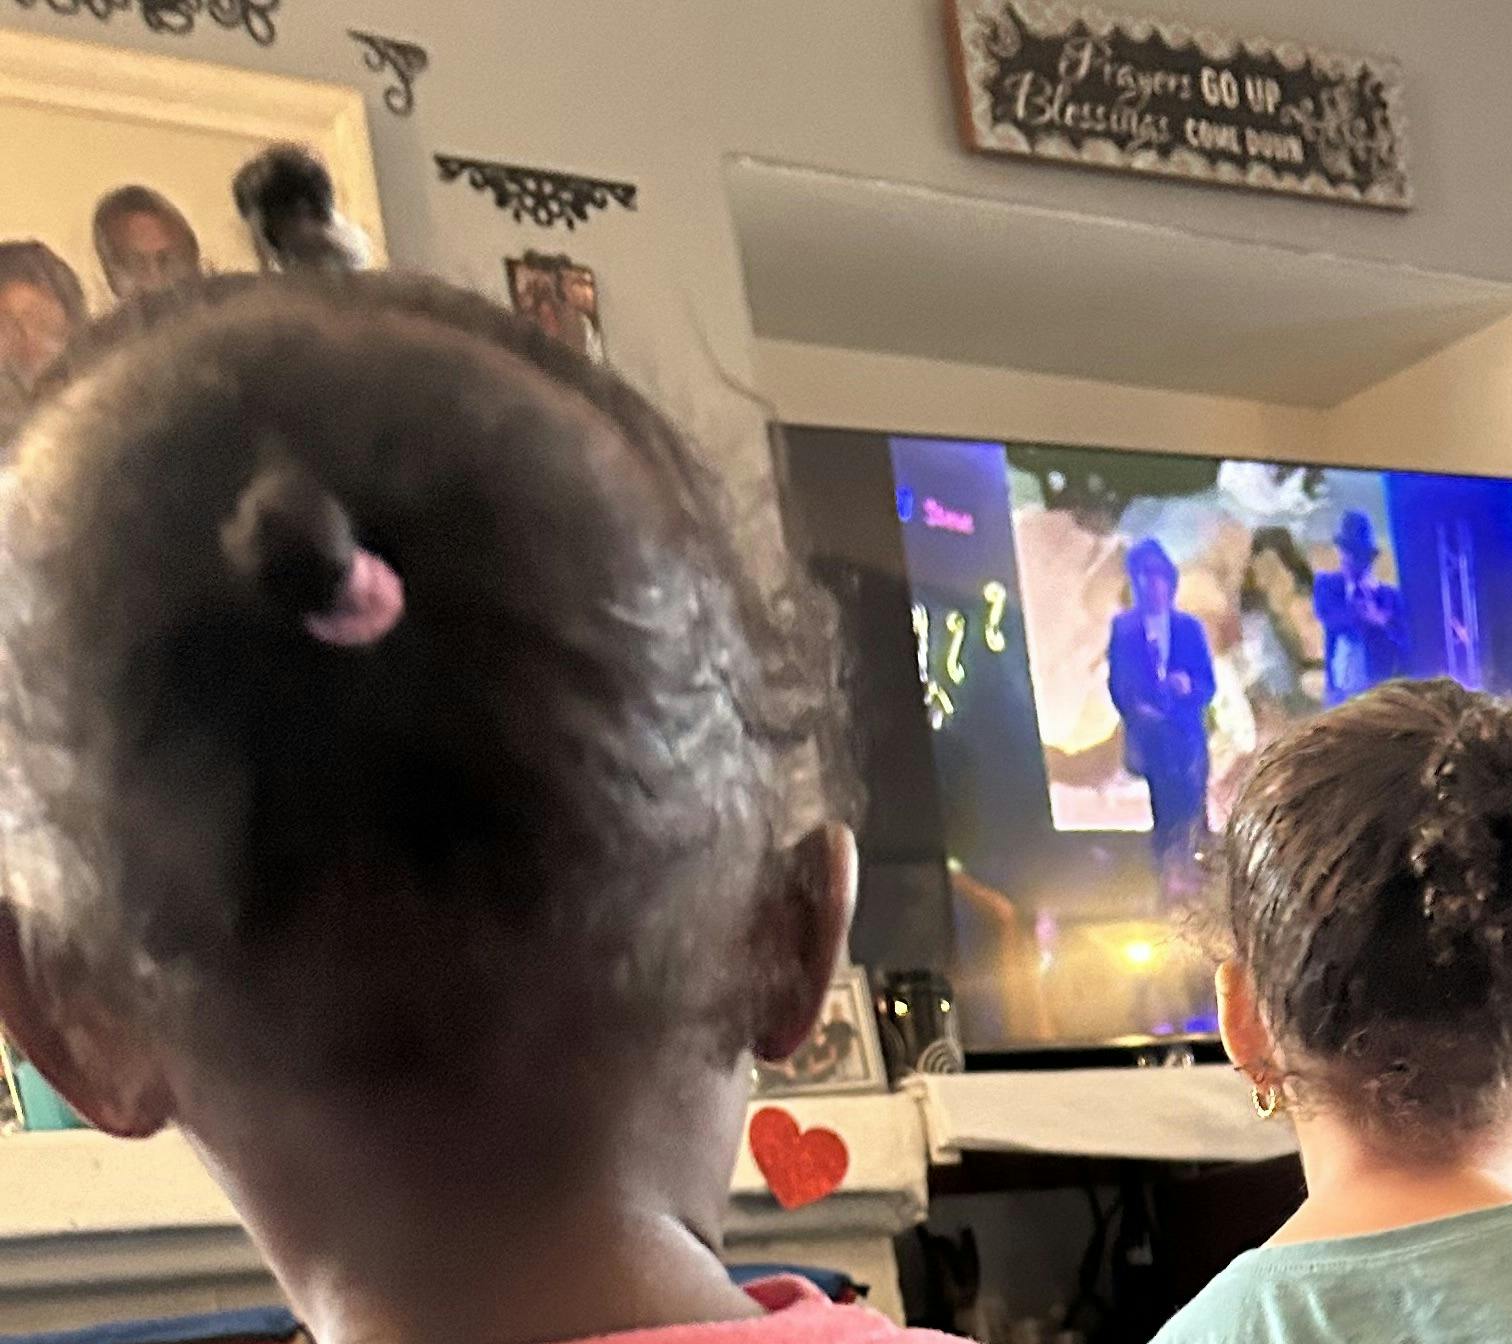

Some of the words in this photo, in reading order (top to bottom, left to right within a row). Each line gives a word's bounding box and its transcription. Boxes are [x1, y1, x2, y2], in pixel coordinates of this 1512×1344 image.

[1004, 72, 1170, 151] Blessings
[1185, 117, 1242, 154] COME
[1245, 128, 1304, 164] DOWN
[1059, 38, 1191, 111] Prayers
[1200, 65, 1240, 110] GO
[1244, 75, 1282, 115] UP
